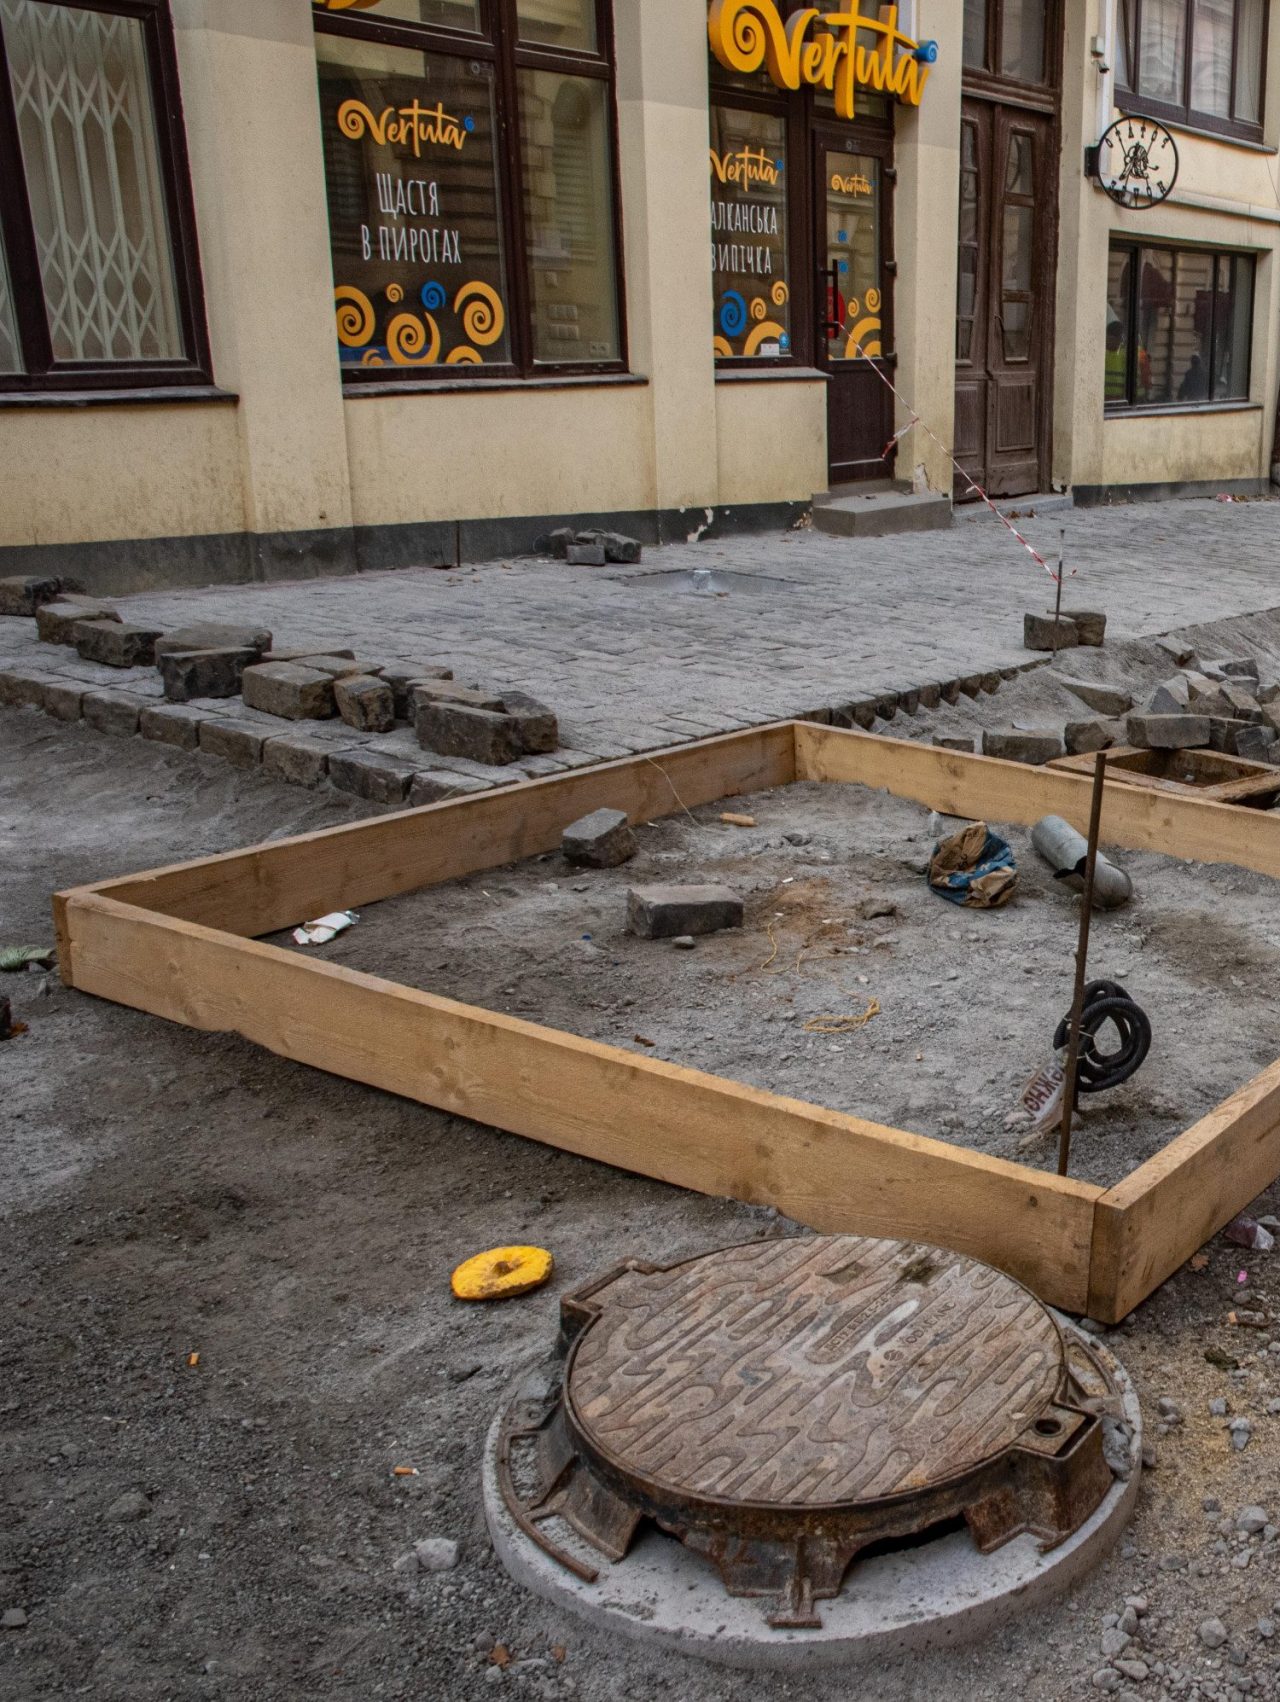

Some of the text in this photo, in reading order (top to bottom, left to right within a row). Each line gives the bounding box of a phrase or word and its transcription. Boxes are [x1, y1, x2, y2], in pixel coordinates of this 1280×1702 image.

[709, 0, 929, 119] Vertuta
[338, 98, 467, 158] Vertuta
[376, 172, 439, 221] ЩАСТЯ
[711, 200, 778, 235] АЛКАНСЬКА
[360, 224, 462, 264] В ПИРОГАХ
